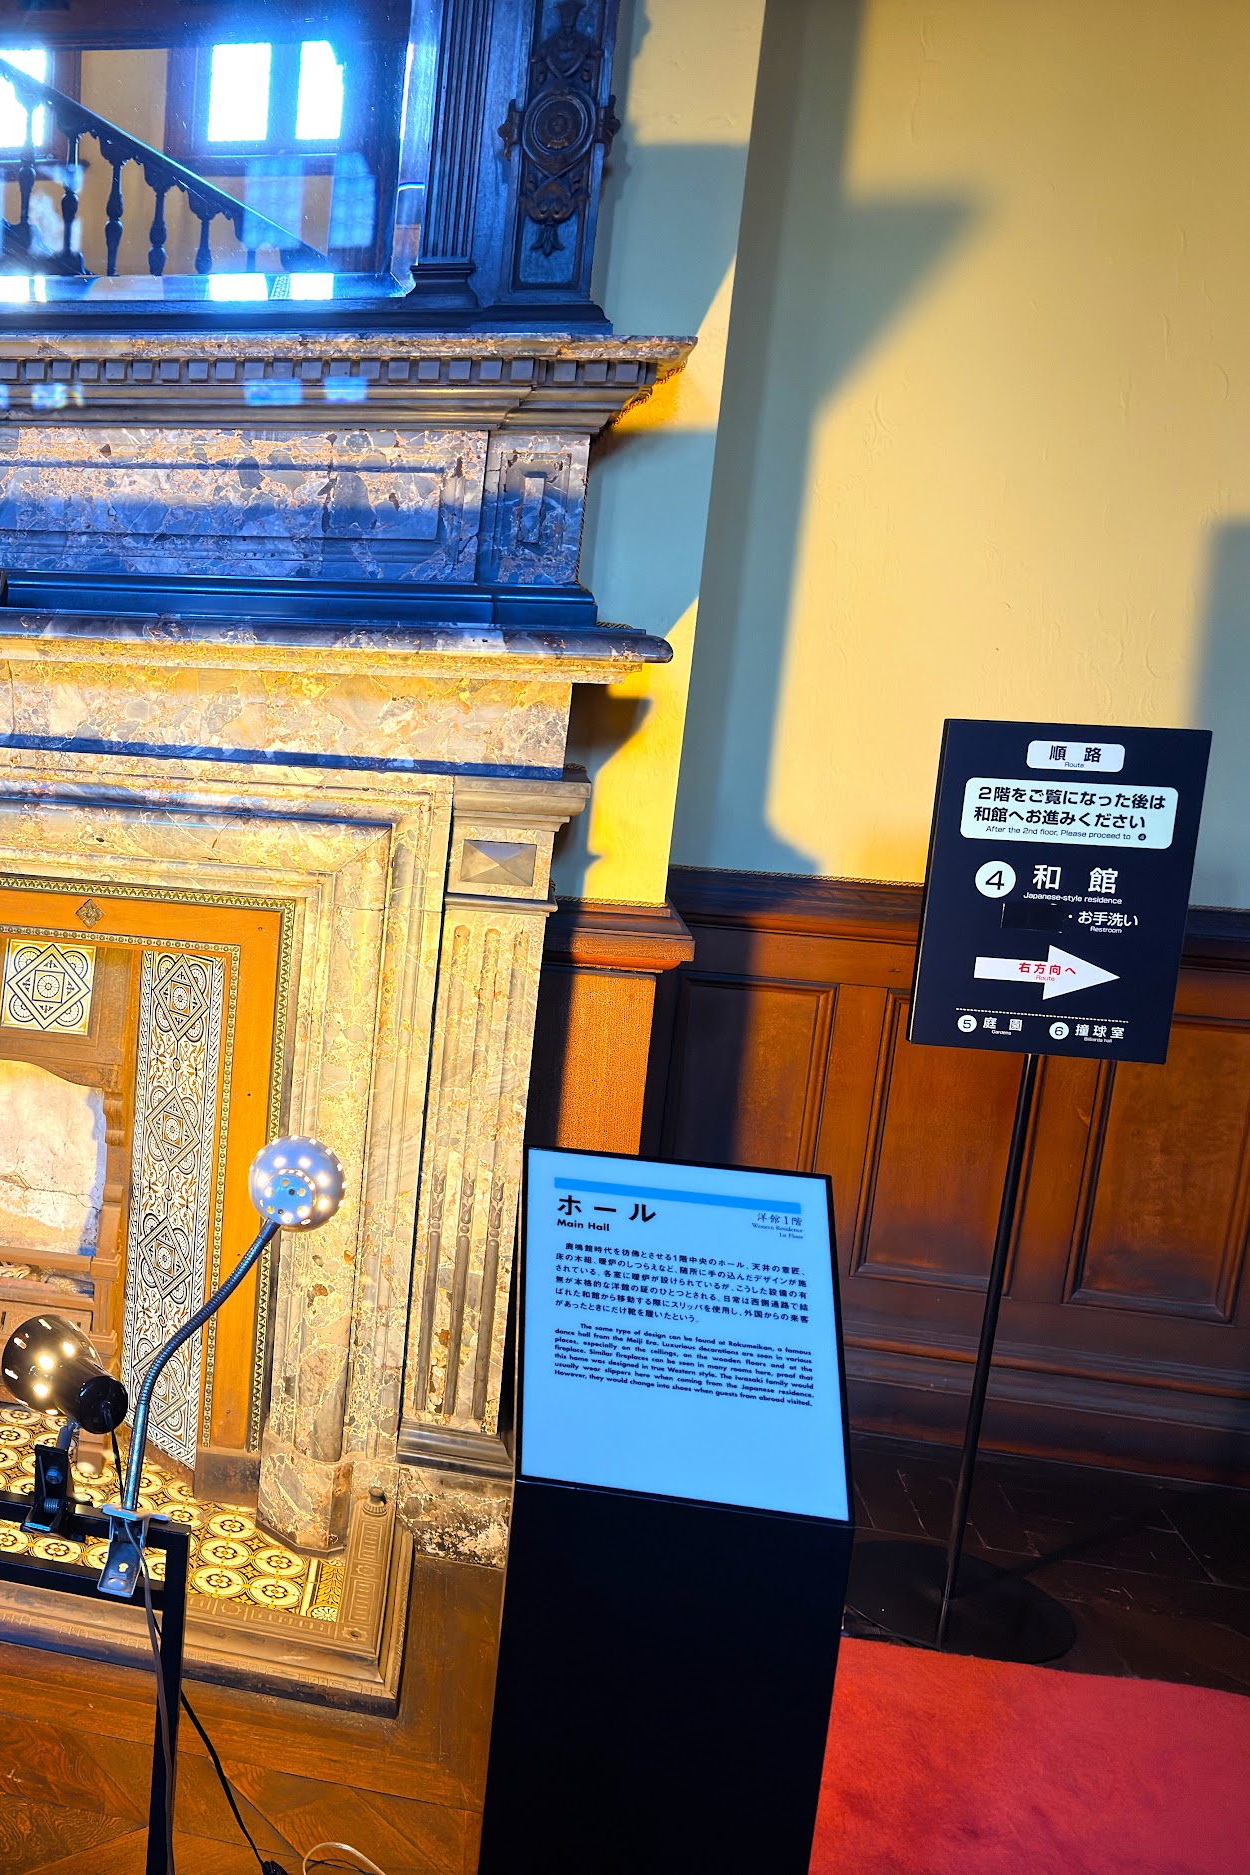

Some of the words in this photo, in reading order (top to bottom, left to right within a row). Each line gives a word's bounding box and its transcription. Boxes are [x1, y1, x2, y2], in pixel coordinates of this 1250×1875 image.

[1049, 745, 1102, 763] 順路
[978, 786, 1166, 810] 2階をご覧になった後は
[973, 806, 1146, 829] 和館へお進みください
[1060, 829, 1087, 838] Please
[1089, 831, 1120, 840] proceed
[1032, 864, 1119, 894] 和館
[1023, 892, 1082, 903] Japanese-style
[1084, 896, 1122, 905] residence
[1090, 926, 1123, 934] Restroom
[1018, 962, 1077, 976] 右方向へ
[982, 1017, 1023, 1031] 庭園
[1074, 1024, 1125, 1039] 撞球室
[557, 1194, 656, 1222] ホール
[556, 1218, 583, 1228] Main
[587, 1221, 609, 1231] Hall
[554, 1327, 575, 1335] dance
[593, 1332, 609, 1340] from
[626, 1336, 643, 1345] Meiji
[661, 1341, 696, 1350] Luxurious
[698, 1345, 738, 1355] decorations
[643, 1330, 666, 1339] design
[695, 1336, 715, 1344] found
[784, 1346, 811, 1355] famous
[582, 1341, 617, 1350] especially
[711, 1356, 741, 1364] wooden
[745, 1358, 766, 1367] floors
[588, 1348, 612, 1356] Similar
[615, 1351, 648, 1361] fireplaces
[707, 1364, 727, 1372] many
[554, 1362, 579, 1370] usually
[604, 1367, 631, 1375] slippers
[634, 1370, 650, 1378] here
[653, 1373, 673, 1381] when
[676, 1377, 702, 1386] coming
[741, 1383, 774, 1393] Japanese
[569, 1353, 588, 1362] home
[607, 1359, 639, 1368] designed
[666, 1366, 696, 1375] Western
[734, 1374, 763, 1383] Iwasaki
[765, 1377, 788, 1387] family
[588, 1373, 604, 1382] they
[629, 1378, 655, 1388] change
[656, 1381, 670, 1389] into
[671, 1383, 691, 1391] shoes
[693, 1386, 713, 1394] when
[739, 1391, 756, 1399] from
[758, 1394, 784, 1403] abroad
